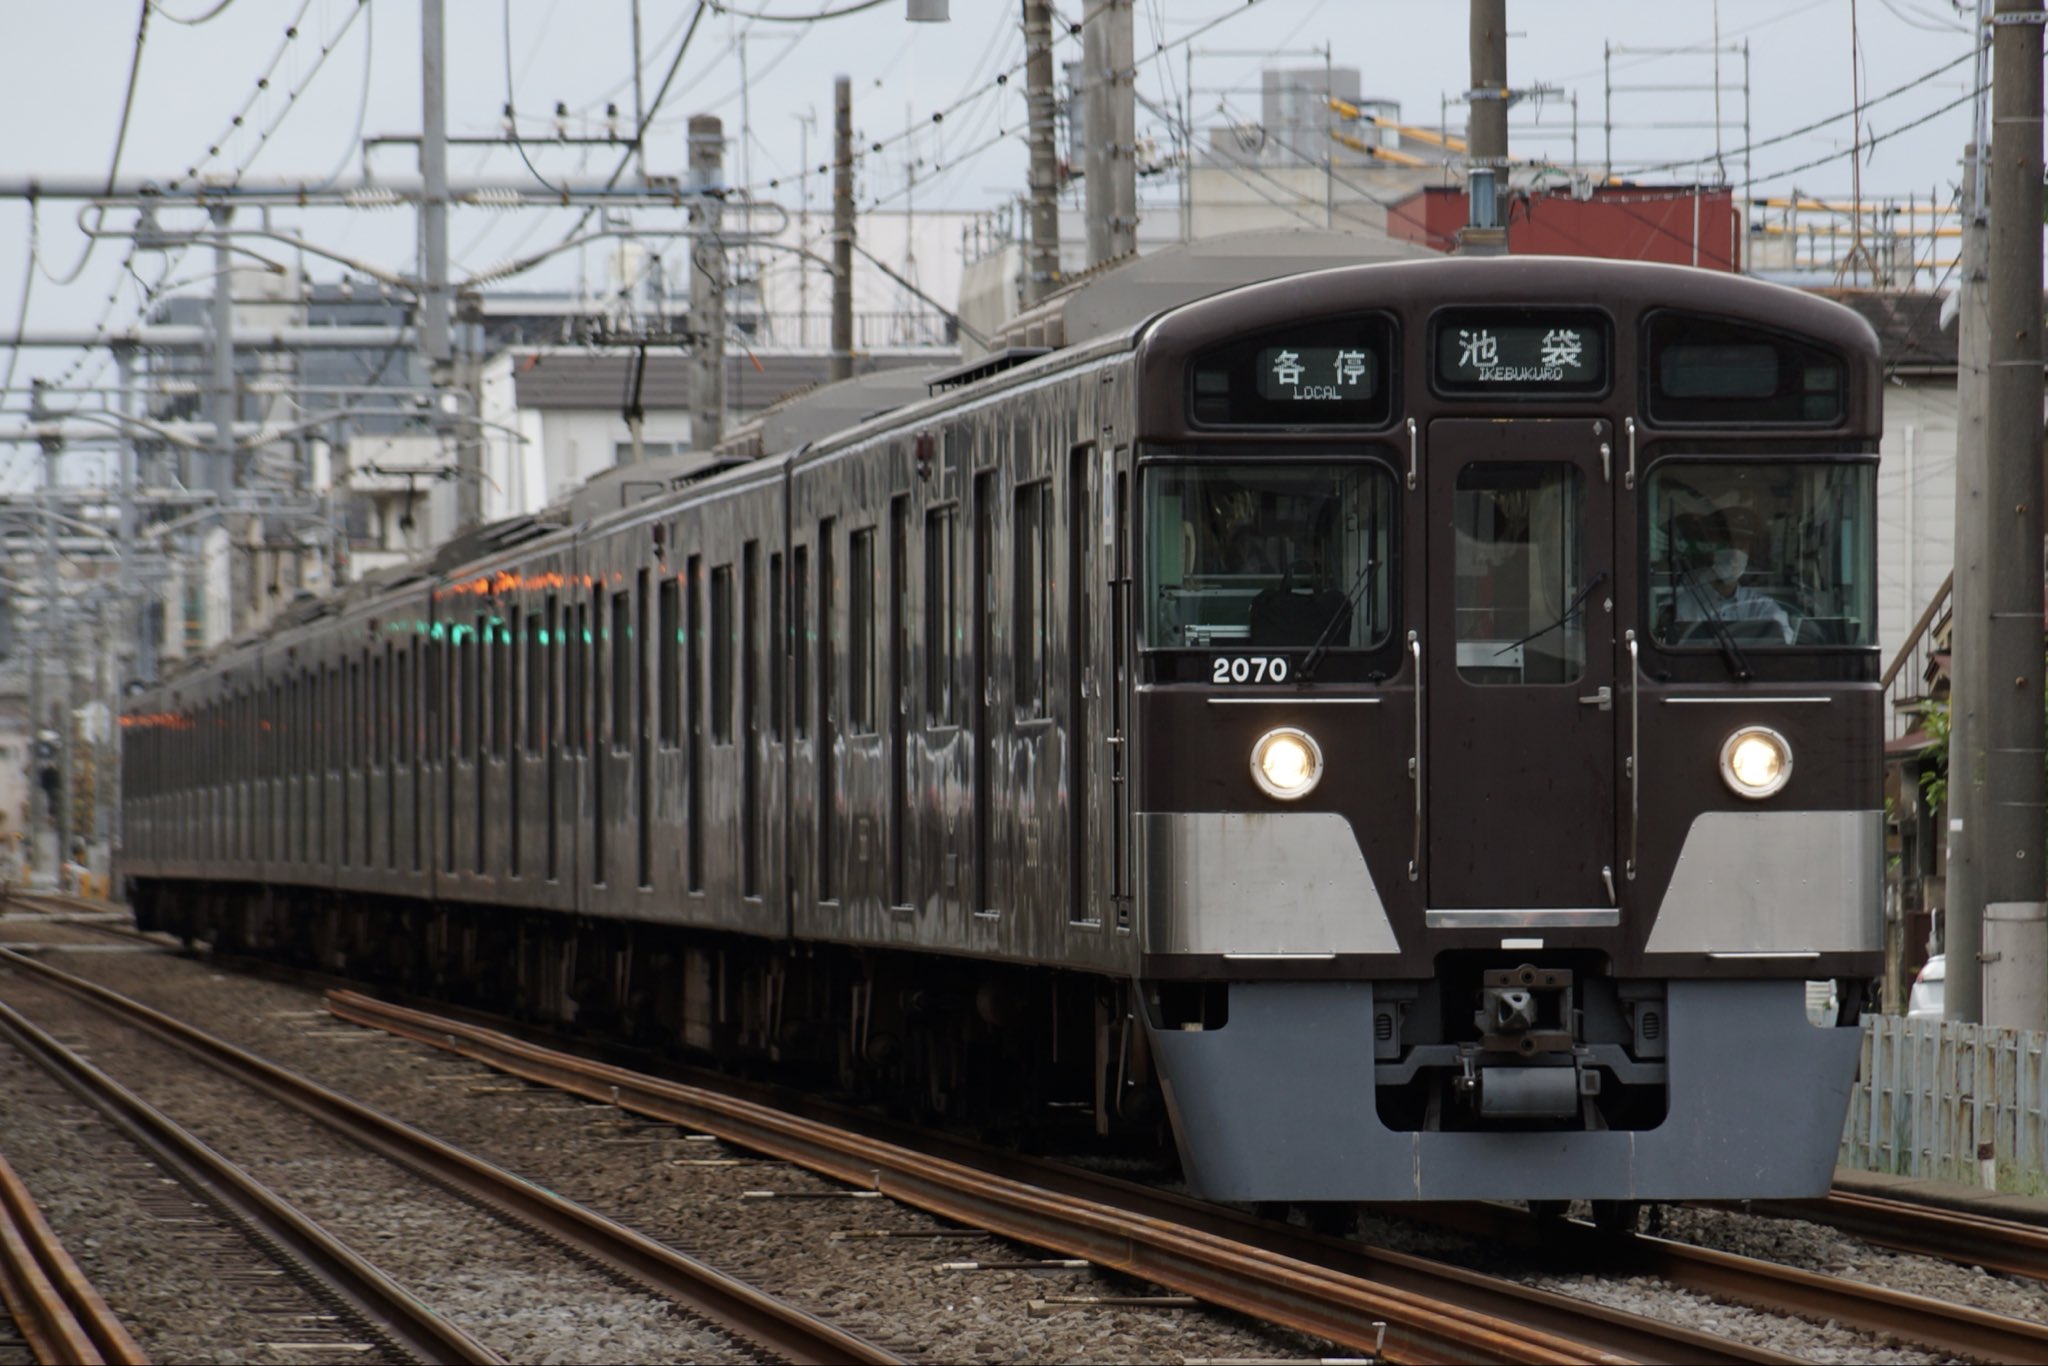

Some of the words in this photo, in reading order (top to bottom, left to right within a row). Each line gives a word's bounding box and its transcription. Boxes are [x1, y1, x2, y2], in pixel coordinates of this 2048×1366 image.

[1458, 329, 1582, 367] 池袋
[1273, 350, 1365, 385] 各停
[1478, 367, 1563, 381] IKEBUKURO
[1293, 386, 1342, 399] LOCAL
[1213, 657, 1287, 683] 2070
